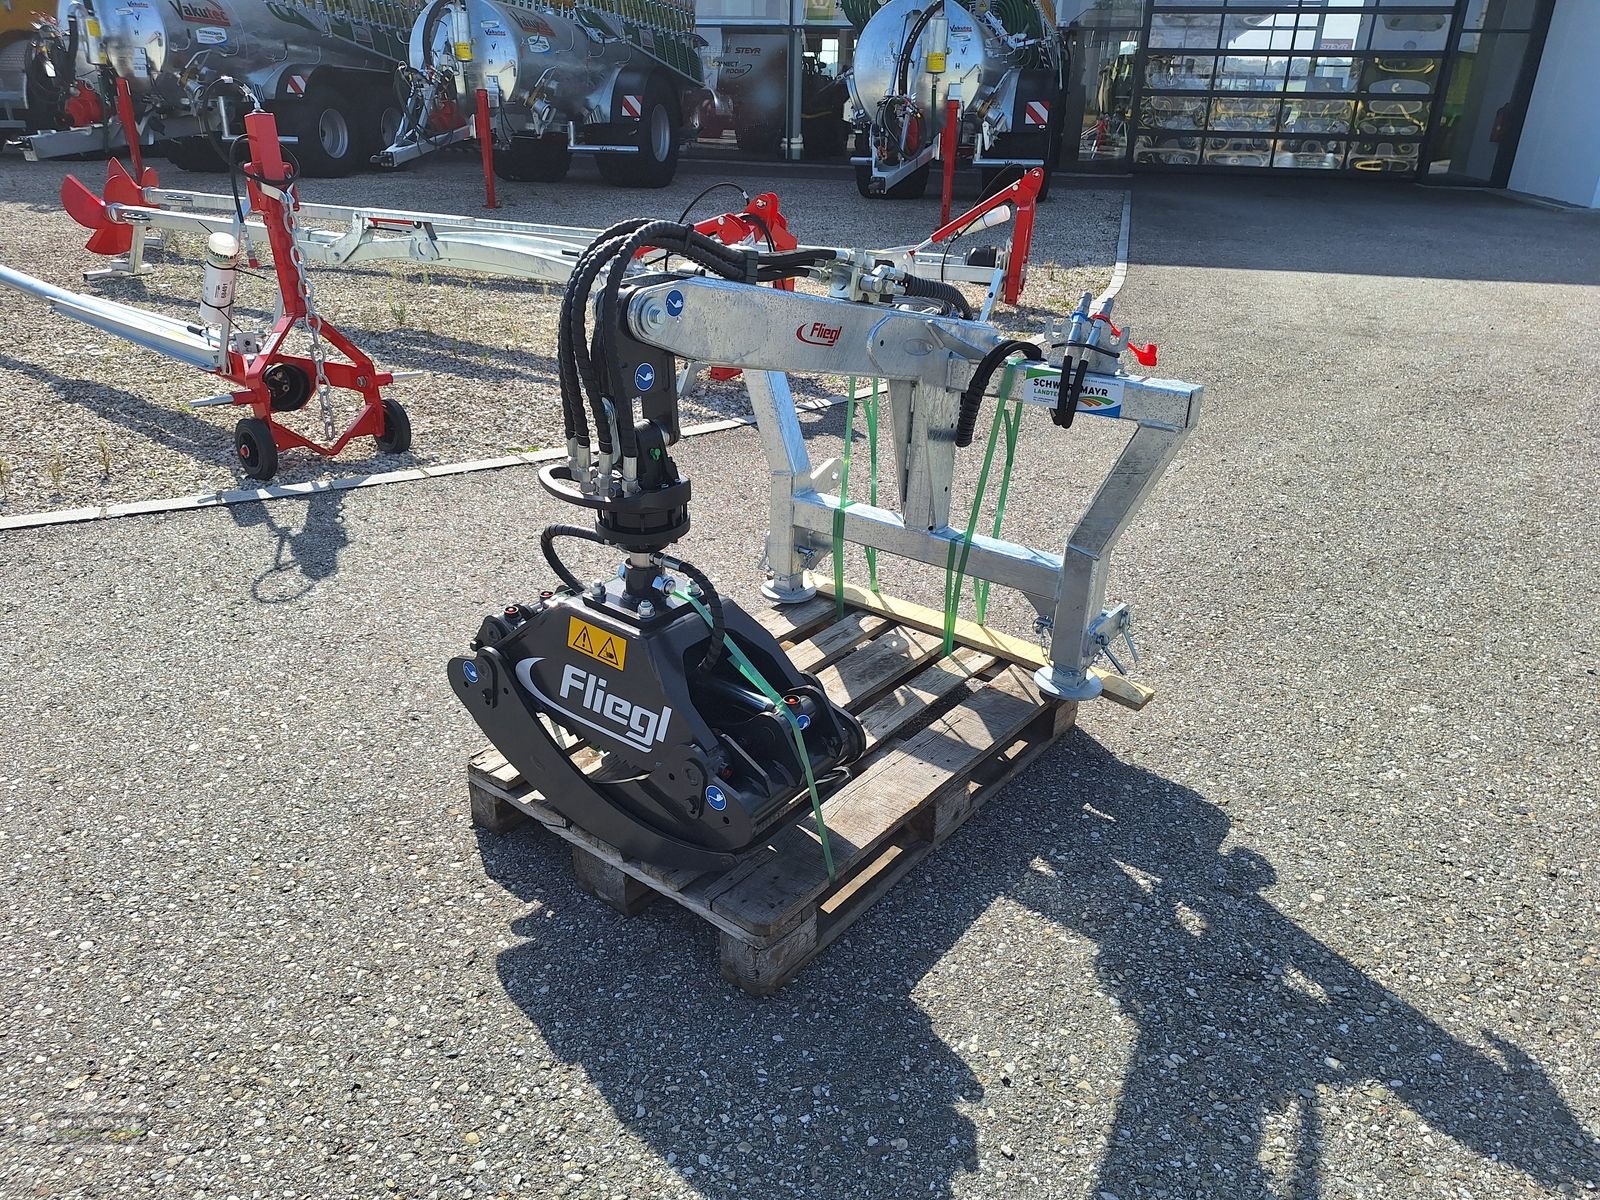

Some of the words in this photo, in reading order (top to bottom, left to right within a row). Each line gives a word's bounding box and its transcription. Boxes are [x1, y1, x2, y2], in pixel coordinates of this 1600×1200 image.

[810, 322, 842, 343] Fliegl
[1033, 378, 1108, 396] SCHWMAYR
[559, 663, 672, 746] Fliegl
